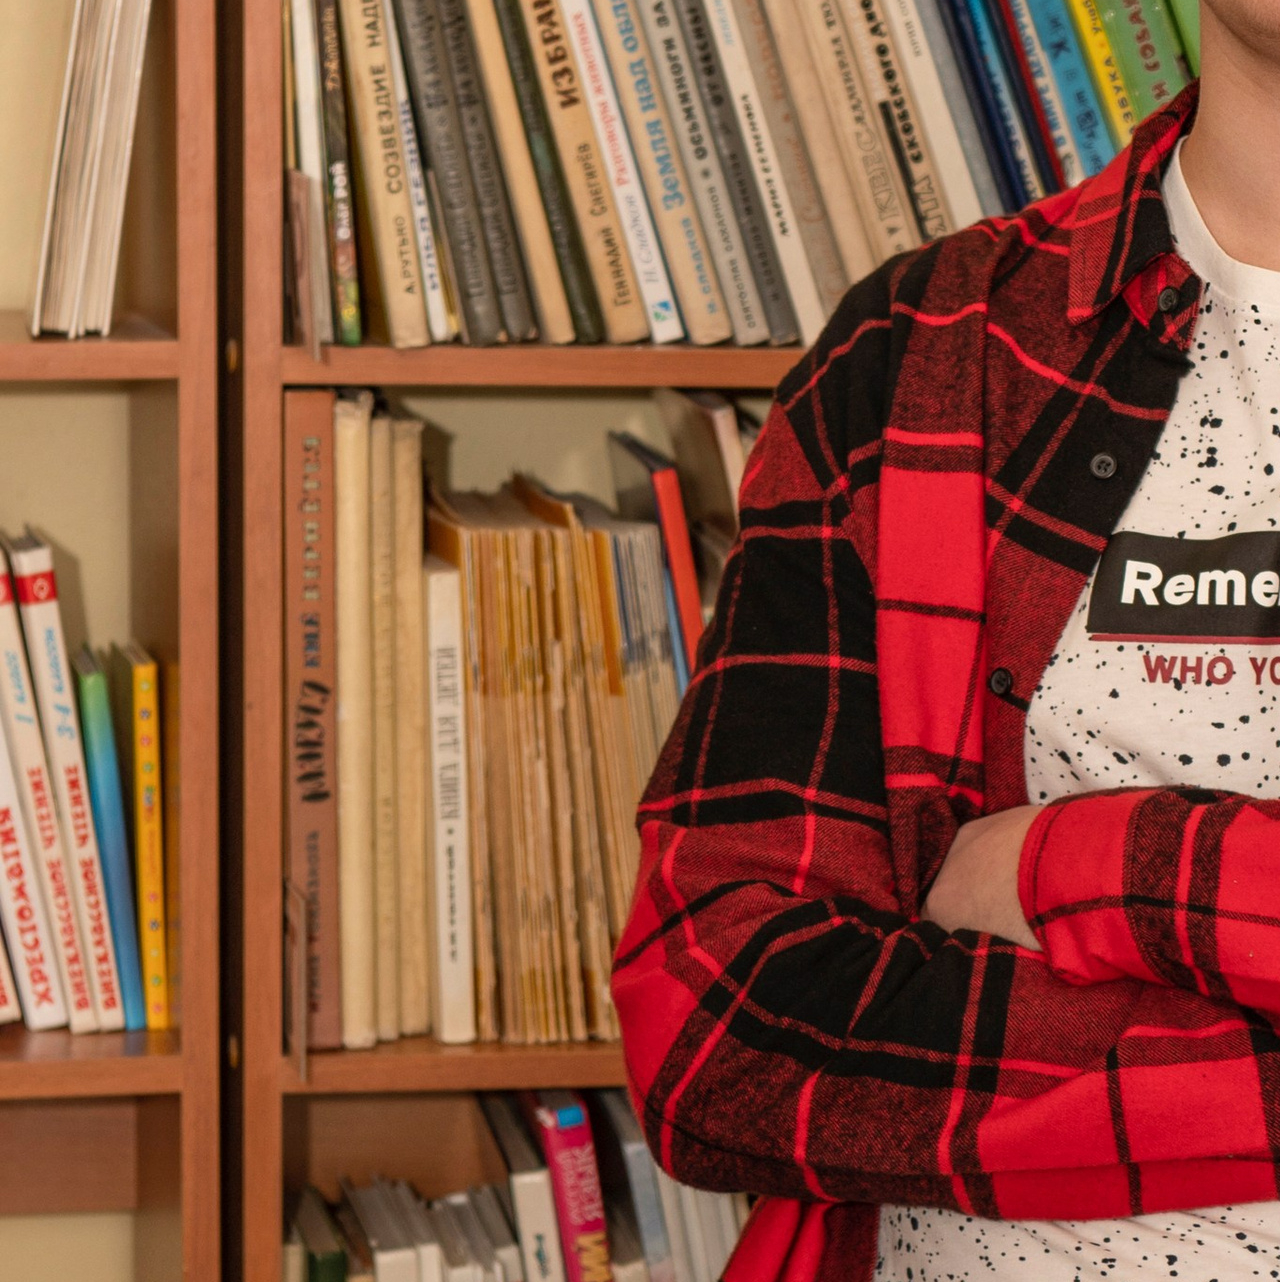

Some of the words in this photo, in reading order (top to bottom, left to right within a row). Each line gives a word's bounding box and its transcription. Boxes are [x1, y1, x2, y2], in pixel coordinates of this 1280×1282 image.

[569, 9, 607, 99] животных
[650, 0, 671, 29] ЗА
[625, 56, 660, 114] над
[660, 35, 710, 162] ОСЬМИНОГИ
[369, 62, 403, 195] СОЗВЕЗДИЕ
[593, 98, 634, 188] Разговоры
[639, 118, 688, 212] Земля
[433, 644, 458, 706] ДЕТЕЙ
[1143, 655, 1234, 686] WHO
[439, 715, 460, 753] ДЛЯ
[25, 765, 57, 850] ЧТЕНИЕ
[63, 763, 92, 847] ЧТЕНИЕ
[439, 761, 460, 820] КНИГА
[44, 857, 91, 1012] ВНЕКЛАССНОЕ
[78, 855, 119, 1011] ВНЕКЛАССНОЕ
